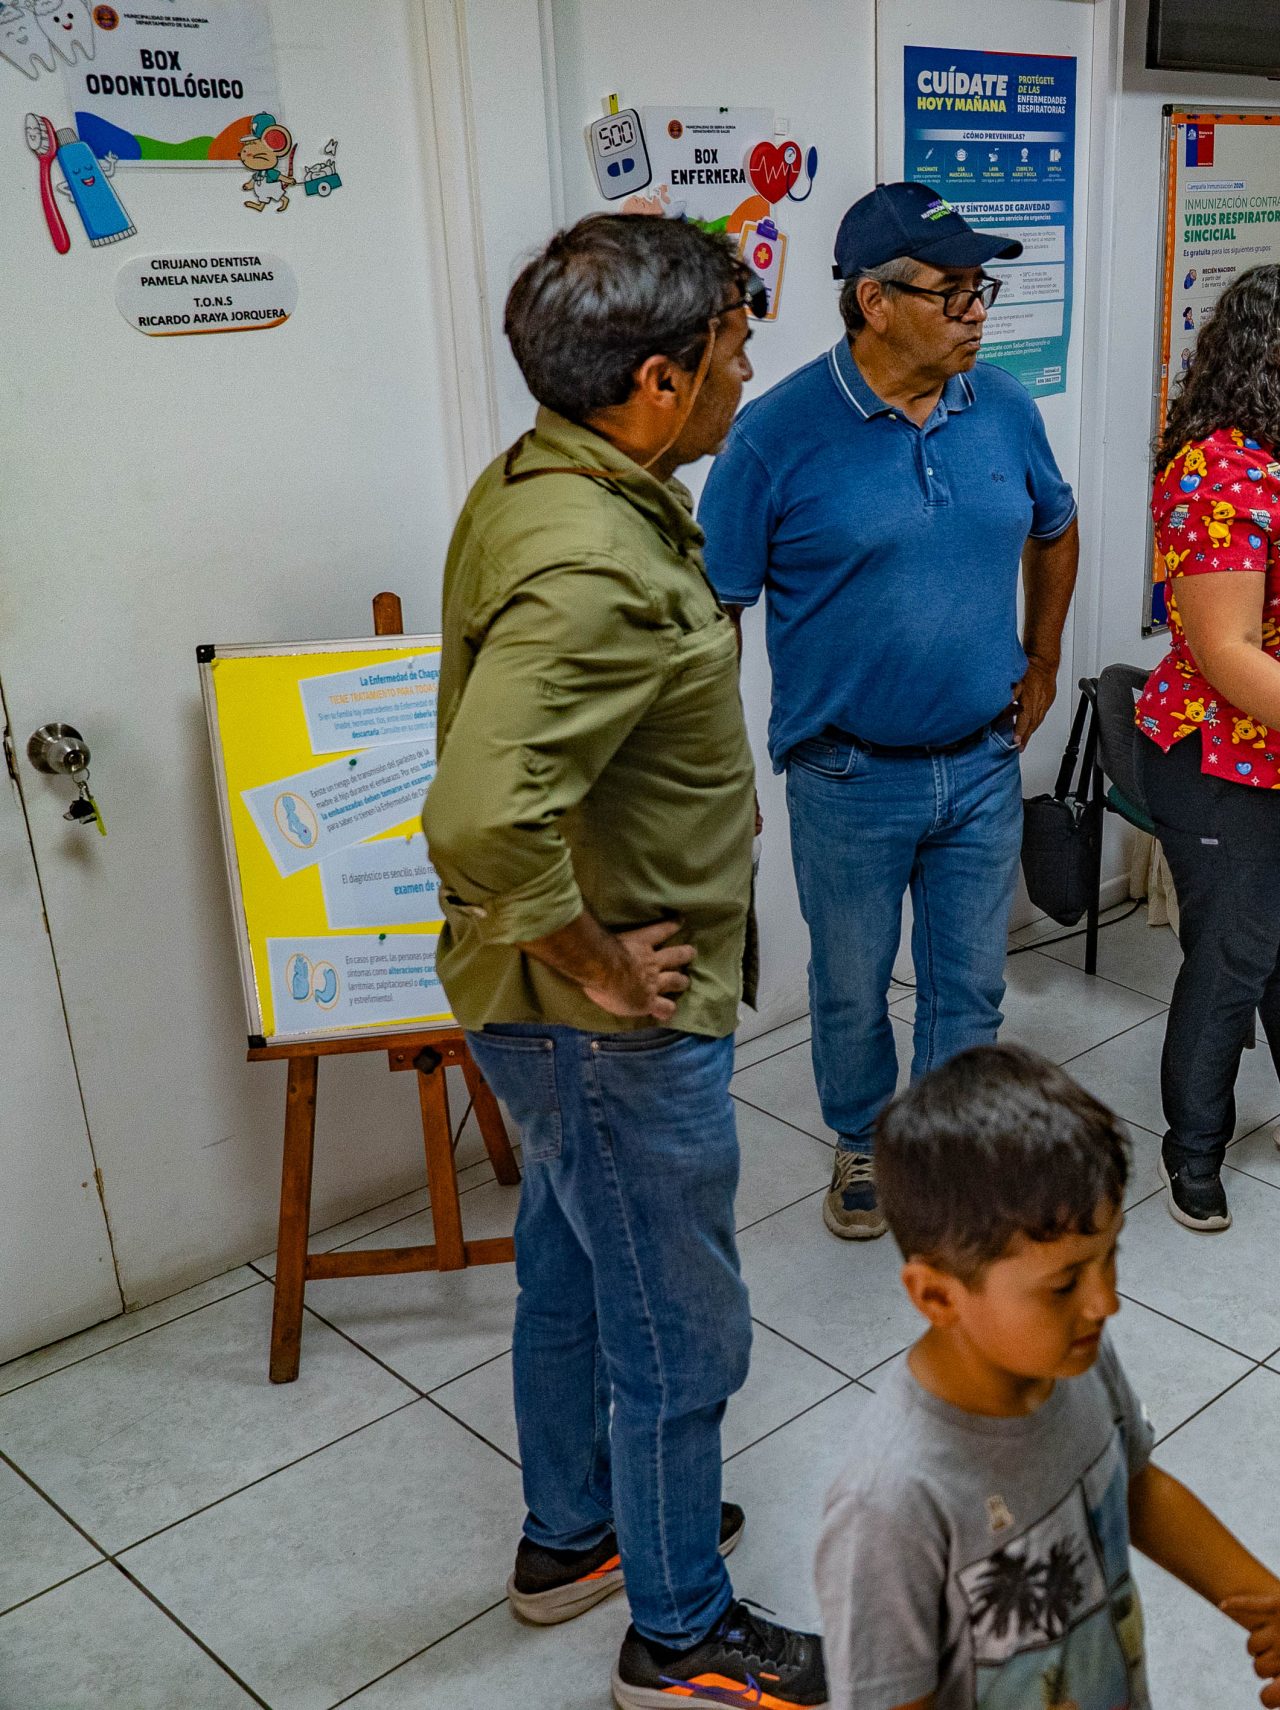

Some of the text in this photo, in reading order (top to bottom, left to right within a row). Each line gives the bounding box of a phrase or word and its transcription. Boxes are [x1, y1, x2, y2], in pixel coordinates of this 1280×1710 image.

[140, 49, 182, 71] BOX
[86, 73, 244, 99] ODONTOLÓGICO
[918, 66, 1009, 96] CUÍDATE
[1019, 74, 1055, 85] PROTÉGETE
[1018, 85, 1040, 94] DE LAS
[918, 96, 1007, 112] HOY Y MAÑANA
[1017, 95, 1067, 105] ENFERMEDADES
[1017, 104, 1065, 114] RESPIRATORIAS
[599, 121, 634, 150] 500
[963, 130, 1025, 140] ¿CÓMO PREVENIRLAS?
[695, 149, 718, 164] BOX
[671, 169, 746, 185] ENFERMERA
[967, 203, 1003, 212] SÍNTOMAS
[1015, 203, 1050, 211] GRAVEDAD
[1185, 196, 1247, 210] INMUNIZACIÓN
[1184, 213, 1216, 226] VIRUS
[1184, 228, 1236, 243] SINCICIAL
[1190, 248, 1210, 257] gratuita
[151, 256, 261, 270] CIRUJANO DENTISTA
[141, 271, 274, 286] PAMELA NAVEA SALINAS
[193, 296, 233, 307] T.O.N.S
[138, 308, 287, 327] RICARDO ARAYA JORQUERA
[360, 677, 368, 686] La
[369, 672, 408, 685] Enfermedad
[342, 874, 348, 884] El
[349, 872, 382, 884] diagnóstico
[383, 872, 390, 880] es
[394, 880, 435, 896] examen de
